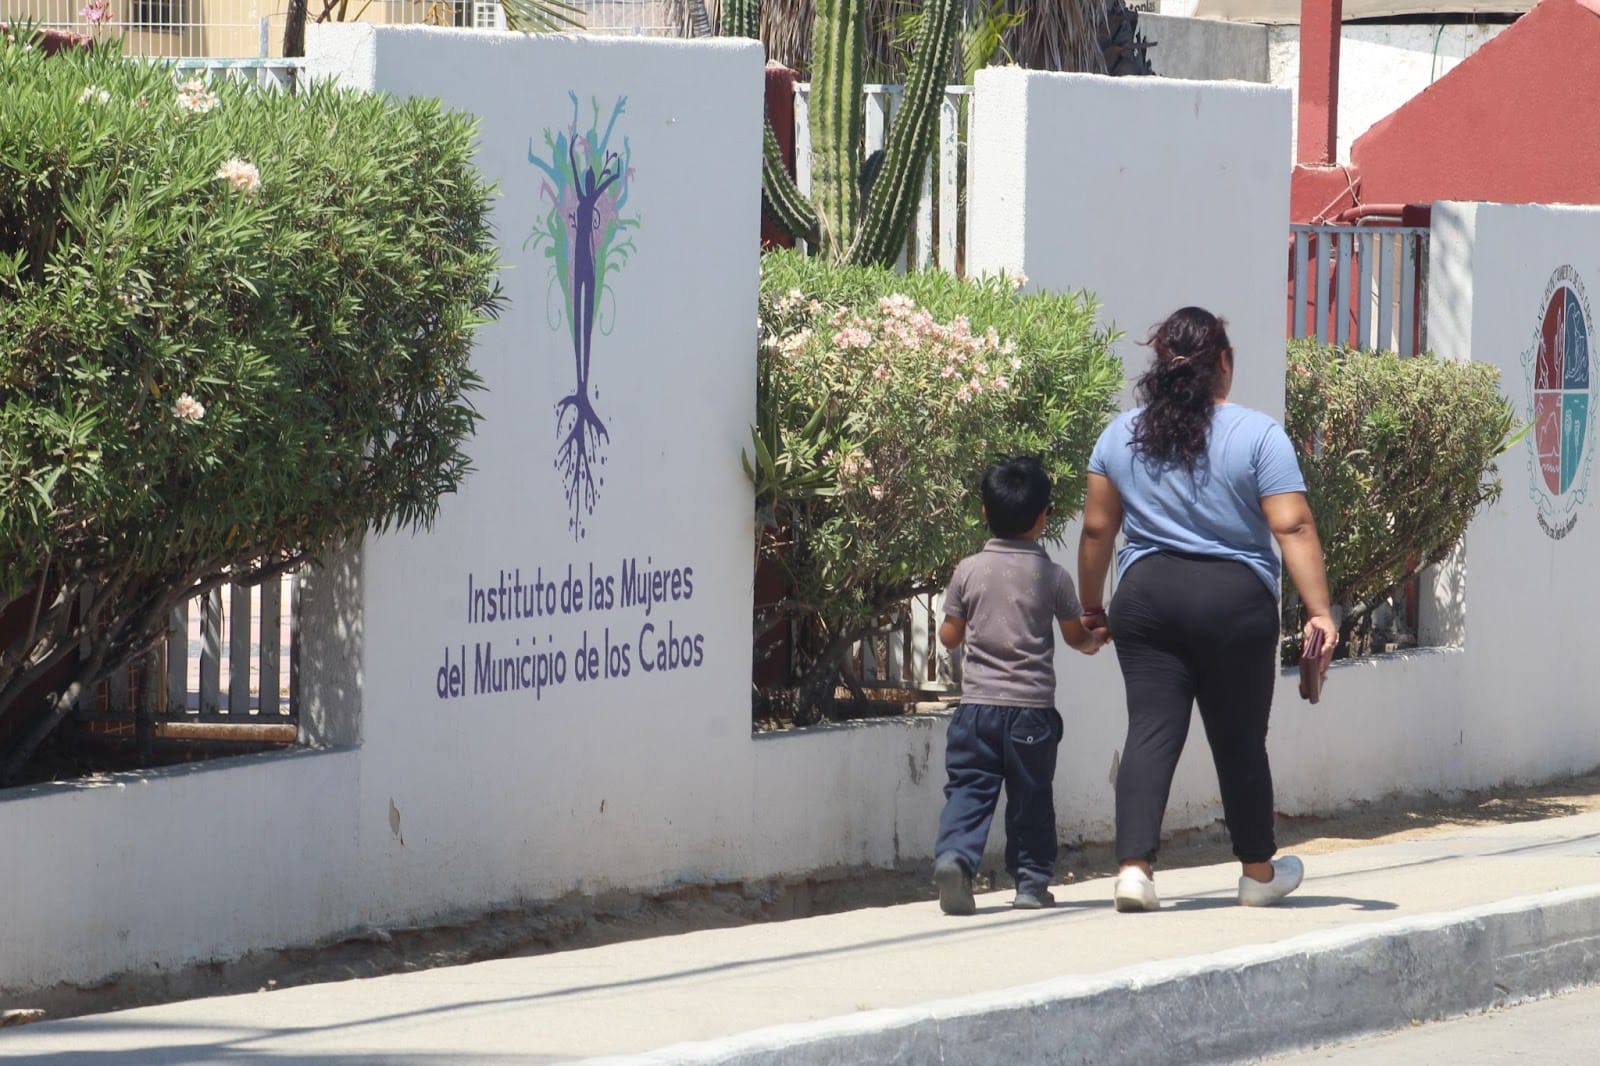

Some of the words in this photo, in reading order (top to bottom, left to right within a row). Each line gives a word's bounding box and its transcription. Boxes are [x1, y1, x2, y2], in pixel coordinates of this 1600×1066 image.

[468, 568, 557, 624] Instituto
[561, 563, 583, 615] de
[589, 562, 614, 612] las
[621, 557, 693, 617] Mujeres
[437, 645, 466, 699] del
[474, 635, 567, 700] Municipio
[575, 631, 600, 682] de
[605, 627, 630, 679] los
[639, 620, 704, 674] Cabos
